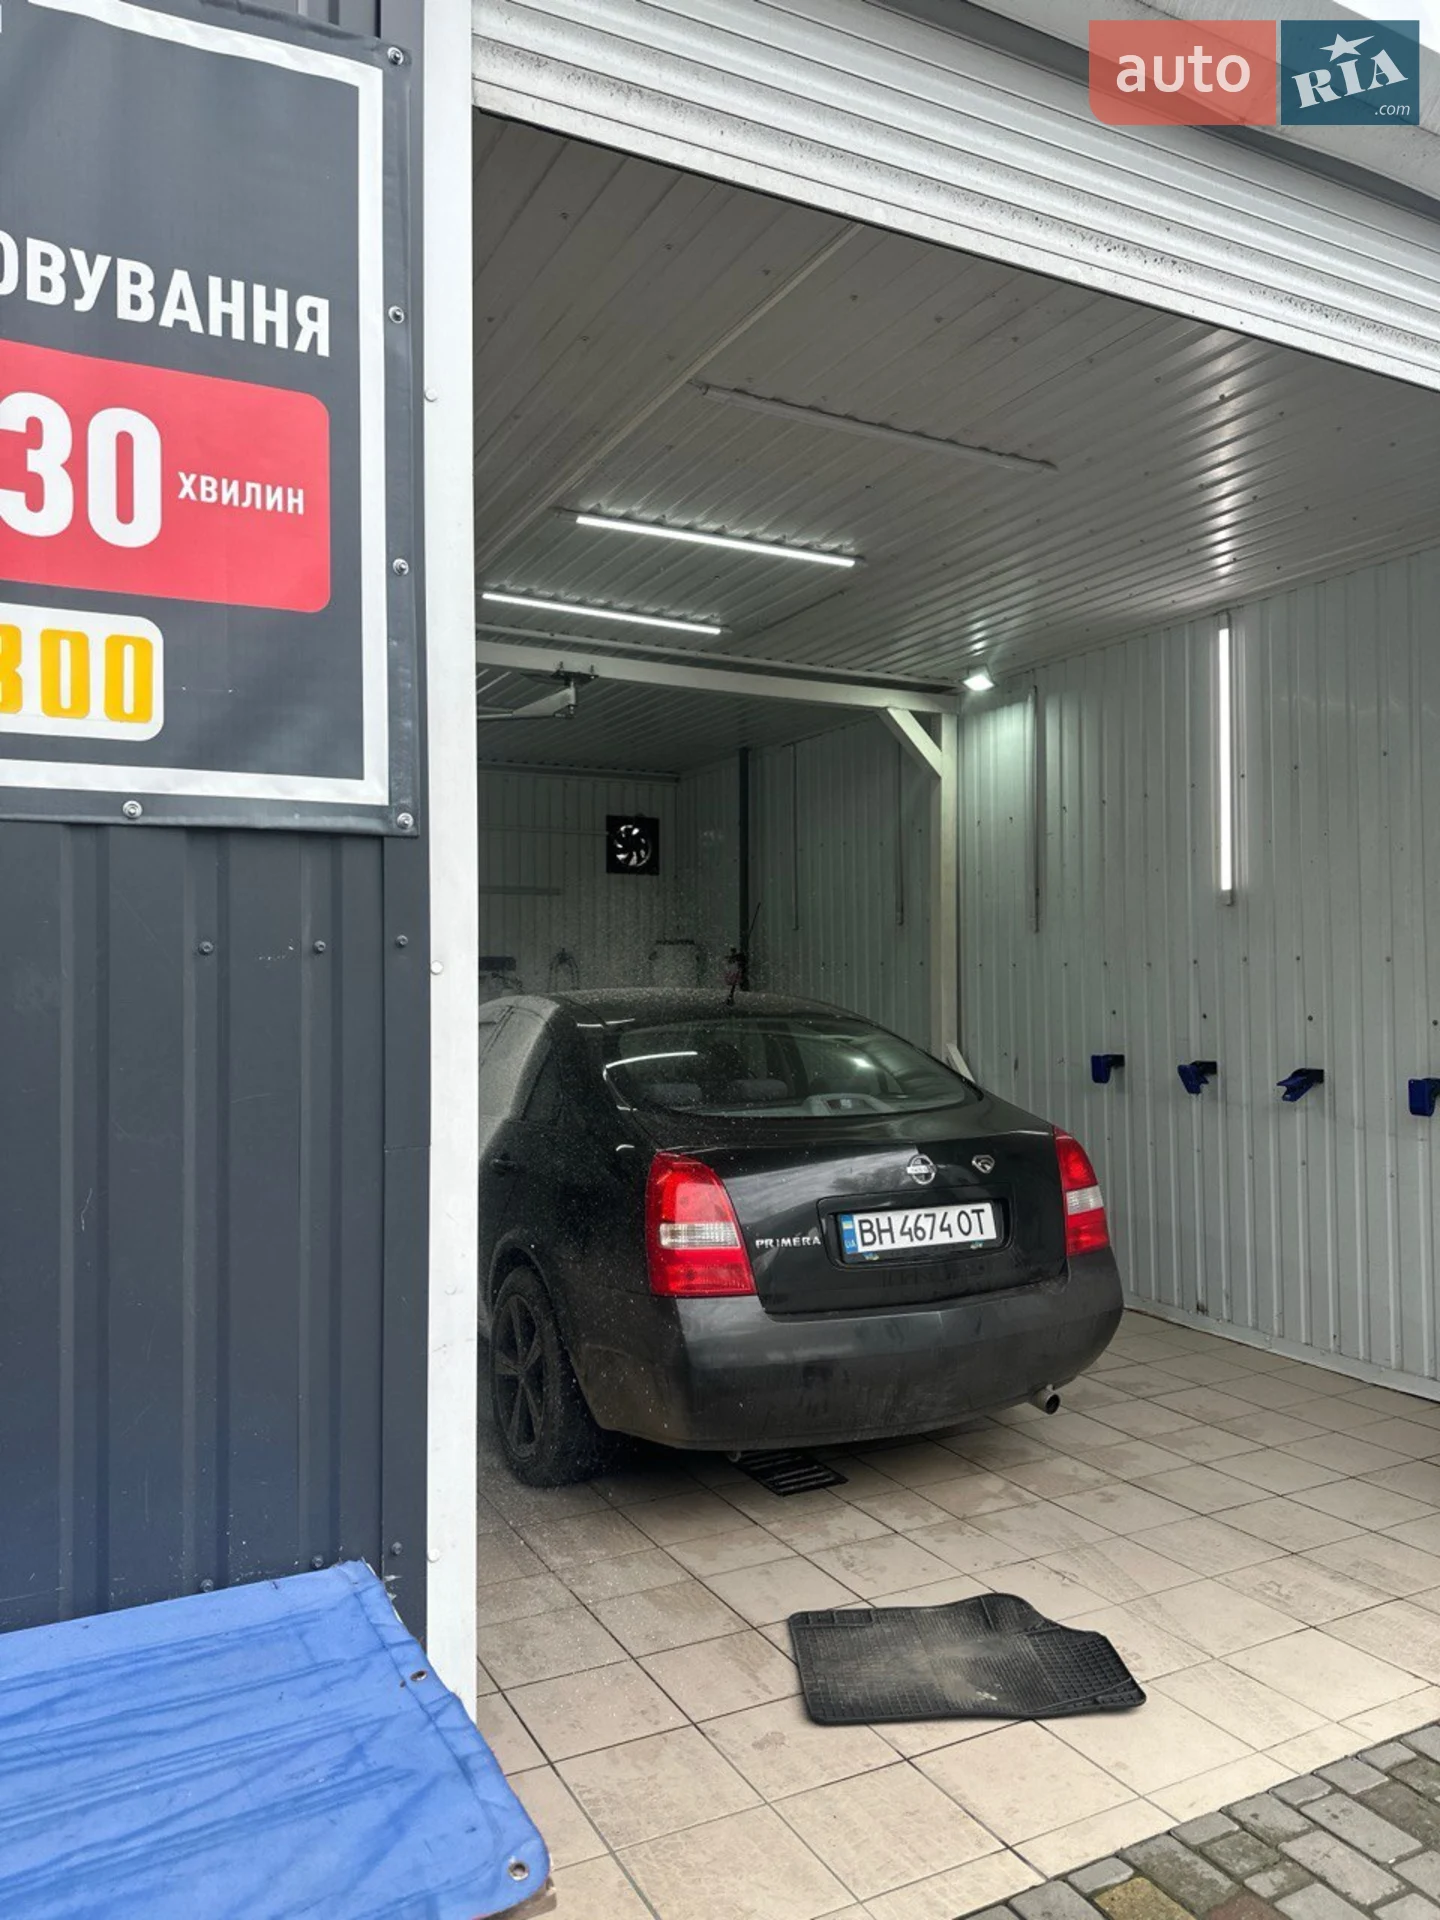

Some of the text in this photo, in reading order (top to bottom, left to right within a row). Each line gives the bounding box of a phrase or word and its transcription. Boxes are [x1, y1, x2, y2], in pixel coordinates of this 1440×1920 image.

[0, 391, 162, 548] 30
[755, 1236, 821, 1249] PRIMERA
[858, 1208, 985, 1247] BH 4674 OT
